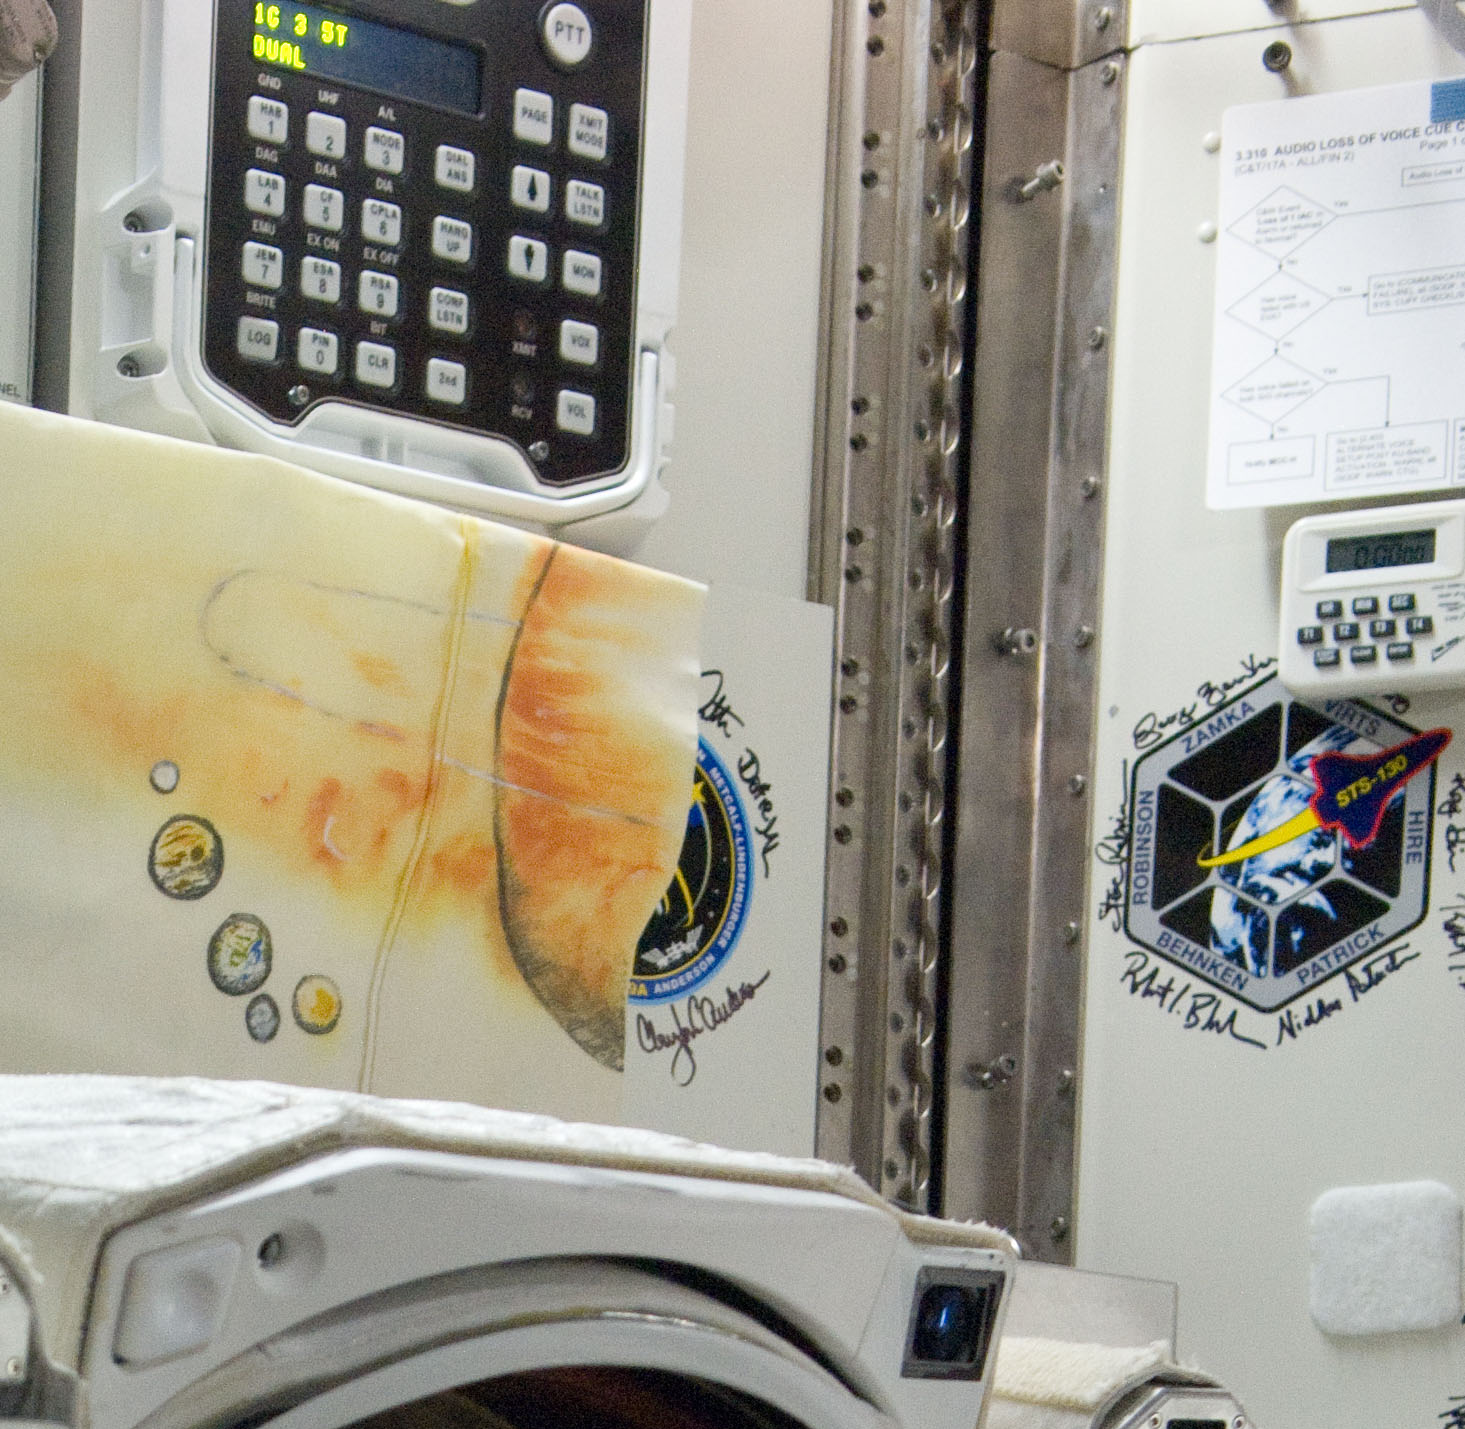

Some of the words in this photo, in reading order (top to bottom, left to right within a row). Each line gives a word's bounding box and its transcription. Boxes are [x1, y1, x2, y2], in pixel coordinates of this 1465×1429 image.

[294, 13, 307, 36] 3
[554, 20, 585, 45] PTT
[253, 34, 307, 69] DUAL
[521, 106, 547, 124] PAGE
[325, 136, 334, 151] 2
[1274, 141, 1316, 157] AUDIO
[1319, 136, 1354, 151] LOSS
[1358, 133, 1377, 146] OF
[1380, 128, 1420, 143] VOICE
[1424, 122, 1451, 136] CUE
[1420, 138, 1448, 152] Page
[263, 192, 271, 207] 4
[446, 239, 460, 252] UP
[256, 248, 277, 263] JEM
[261, 264, 269, 279] 7
[572, 263, 595, 280] MON
[376, 293, 385, 309] 9
[437, 309, 463, 325] LSTN
[247, 330, 271, 346] LOG
[312, 333, 330, 347] PIN
[571, 333, 590, 349] VOX
[368, 354, 389, 370] CLR
[438, 371, 457, 386] 2nd
[567, 402, 586, 419] VOL
[1325, 700, 1382, 736] VIRTS
[1180, 702, 1256, 754] ZAMKA
[1336, 754, 1409, 807] STS-130
[1406, 811, 1425, 864] HIRE
[1135, 789, 1155, 905] ROBINSON
[1155, 930, 1249, 991] BEHNKEN
[1297, 922, 1385, 985] PATRICK
[654, 953, 716, 994] ANDERSON
